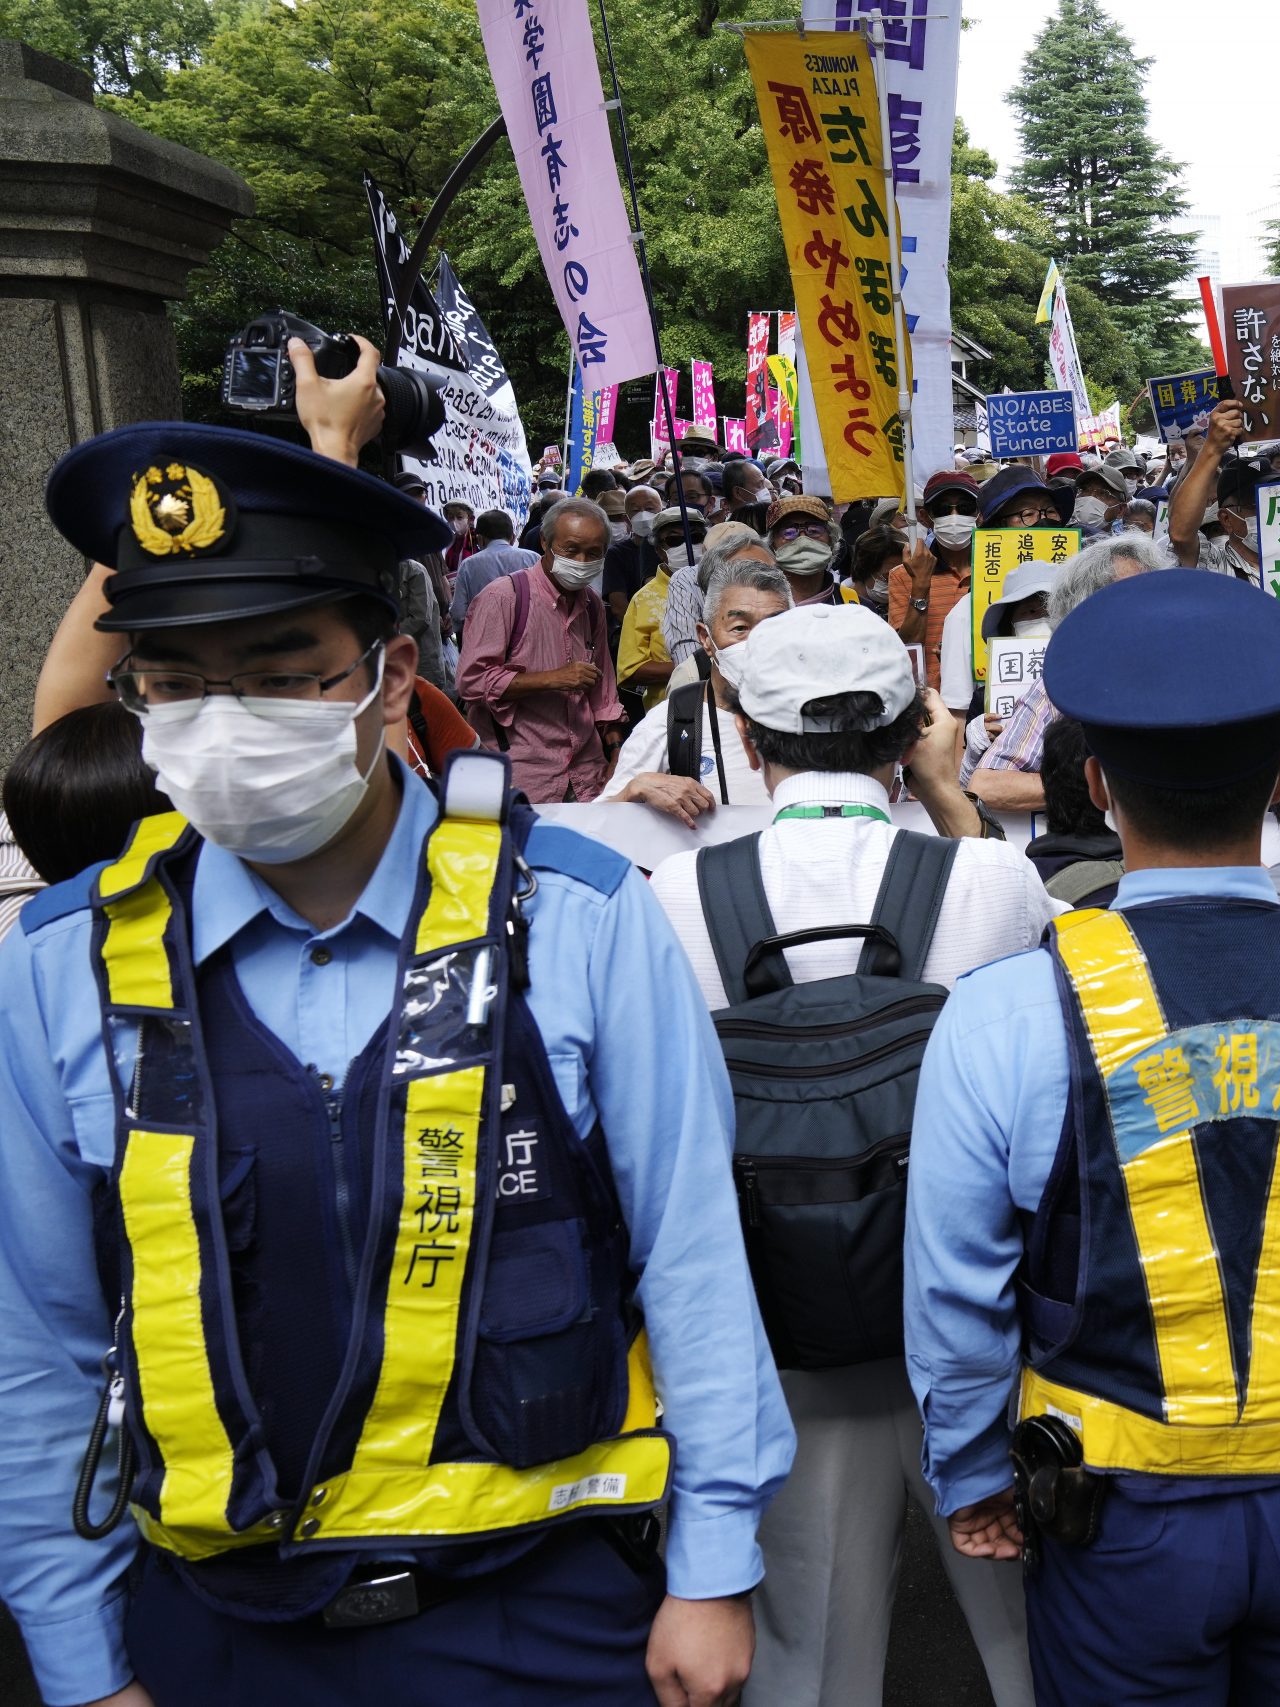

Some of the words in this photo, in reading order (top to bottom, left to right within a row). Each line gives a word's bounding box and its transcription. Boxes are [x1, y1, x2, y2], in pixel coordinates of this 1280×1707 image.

[1233, 308, 1270, 433] 許さない
[992, 417, 1051, 436] State
[995, 432, 1074, 453] Funeral
[998, 647, 1045, 683] 国葬
[497, 1130, 539, 1168] 庁
[404, 1127, 464, 1289] 警視庁
